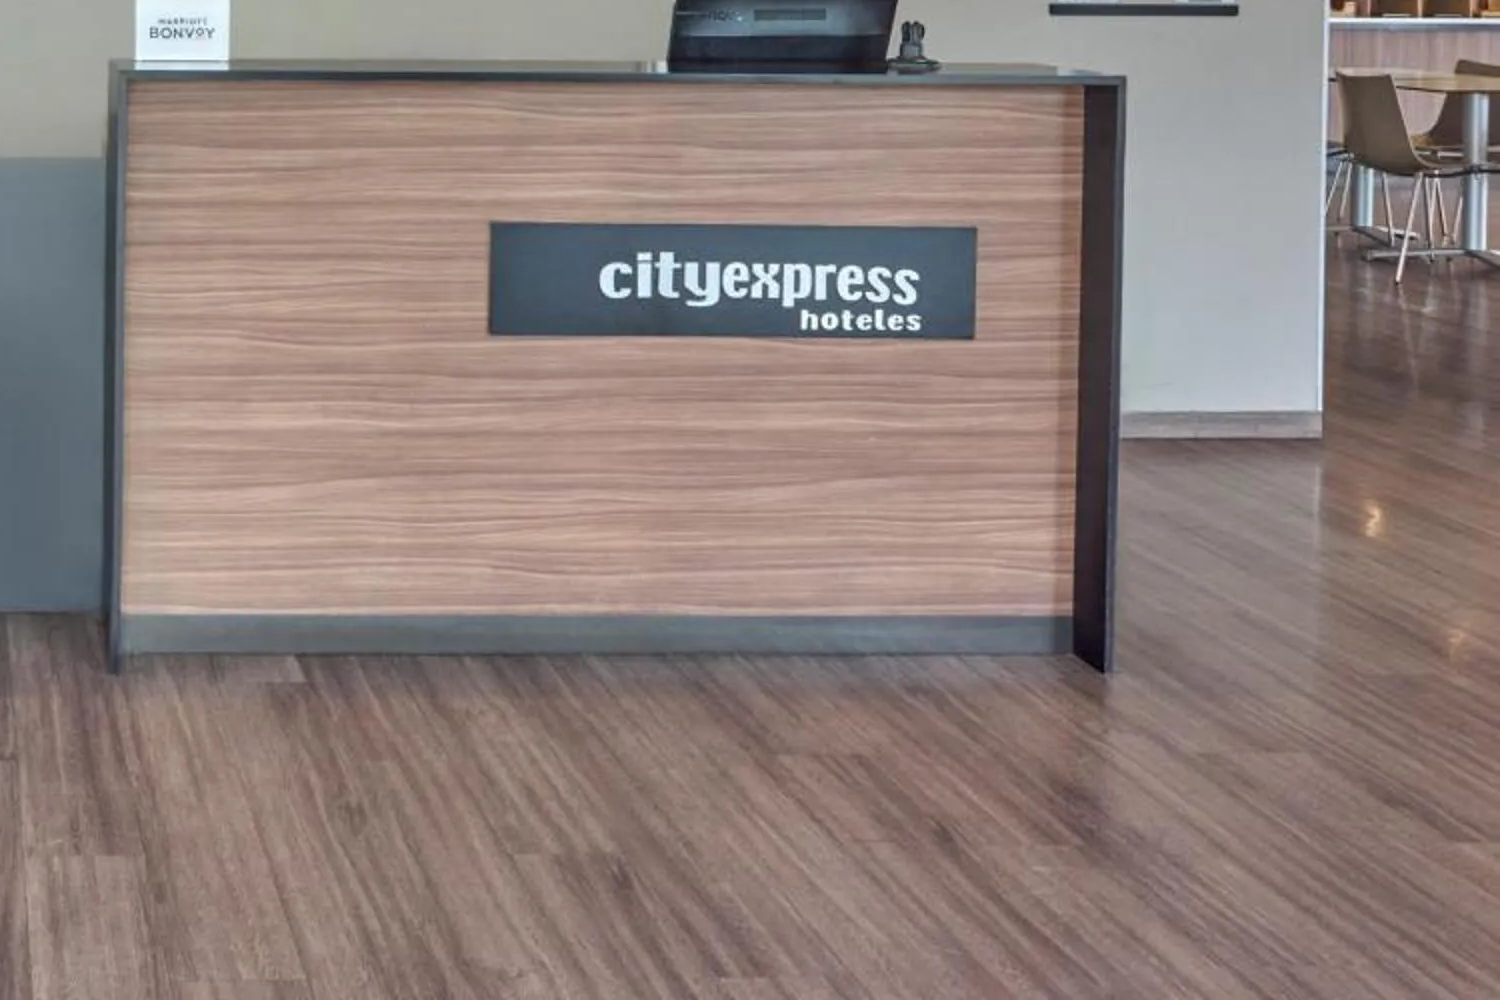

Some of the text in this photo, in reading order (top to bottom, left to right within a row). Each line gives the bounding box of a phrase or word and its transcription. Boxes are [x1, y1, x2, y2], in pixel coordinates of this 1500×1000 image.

[148, 27, 215, 39] BONVOY
[599, 251, 921, 308] cityexpress
[801, 309, 922, 331] hoteles
